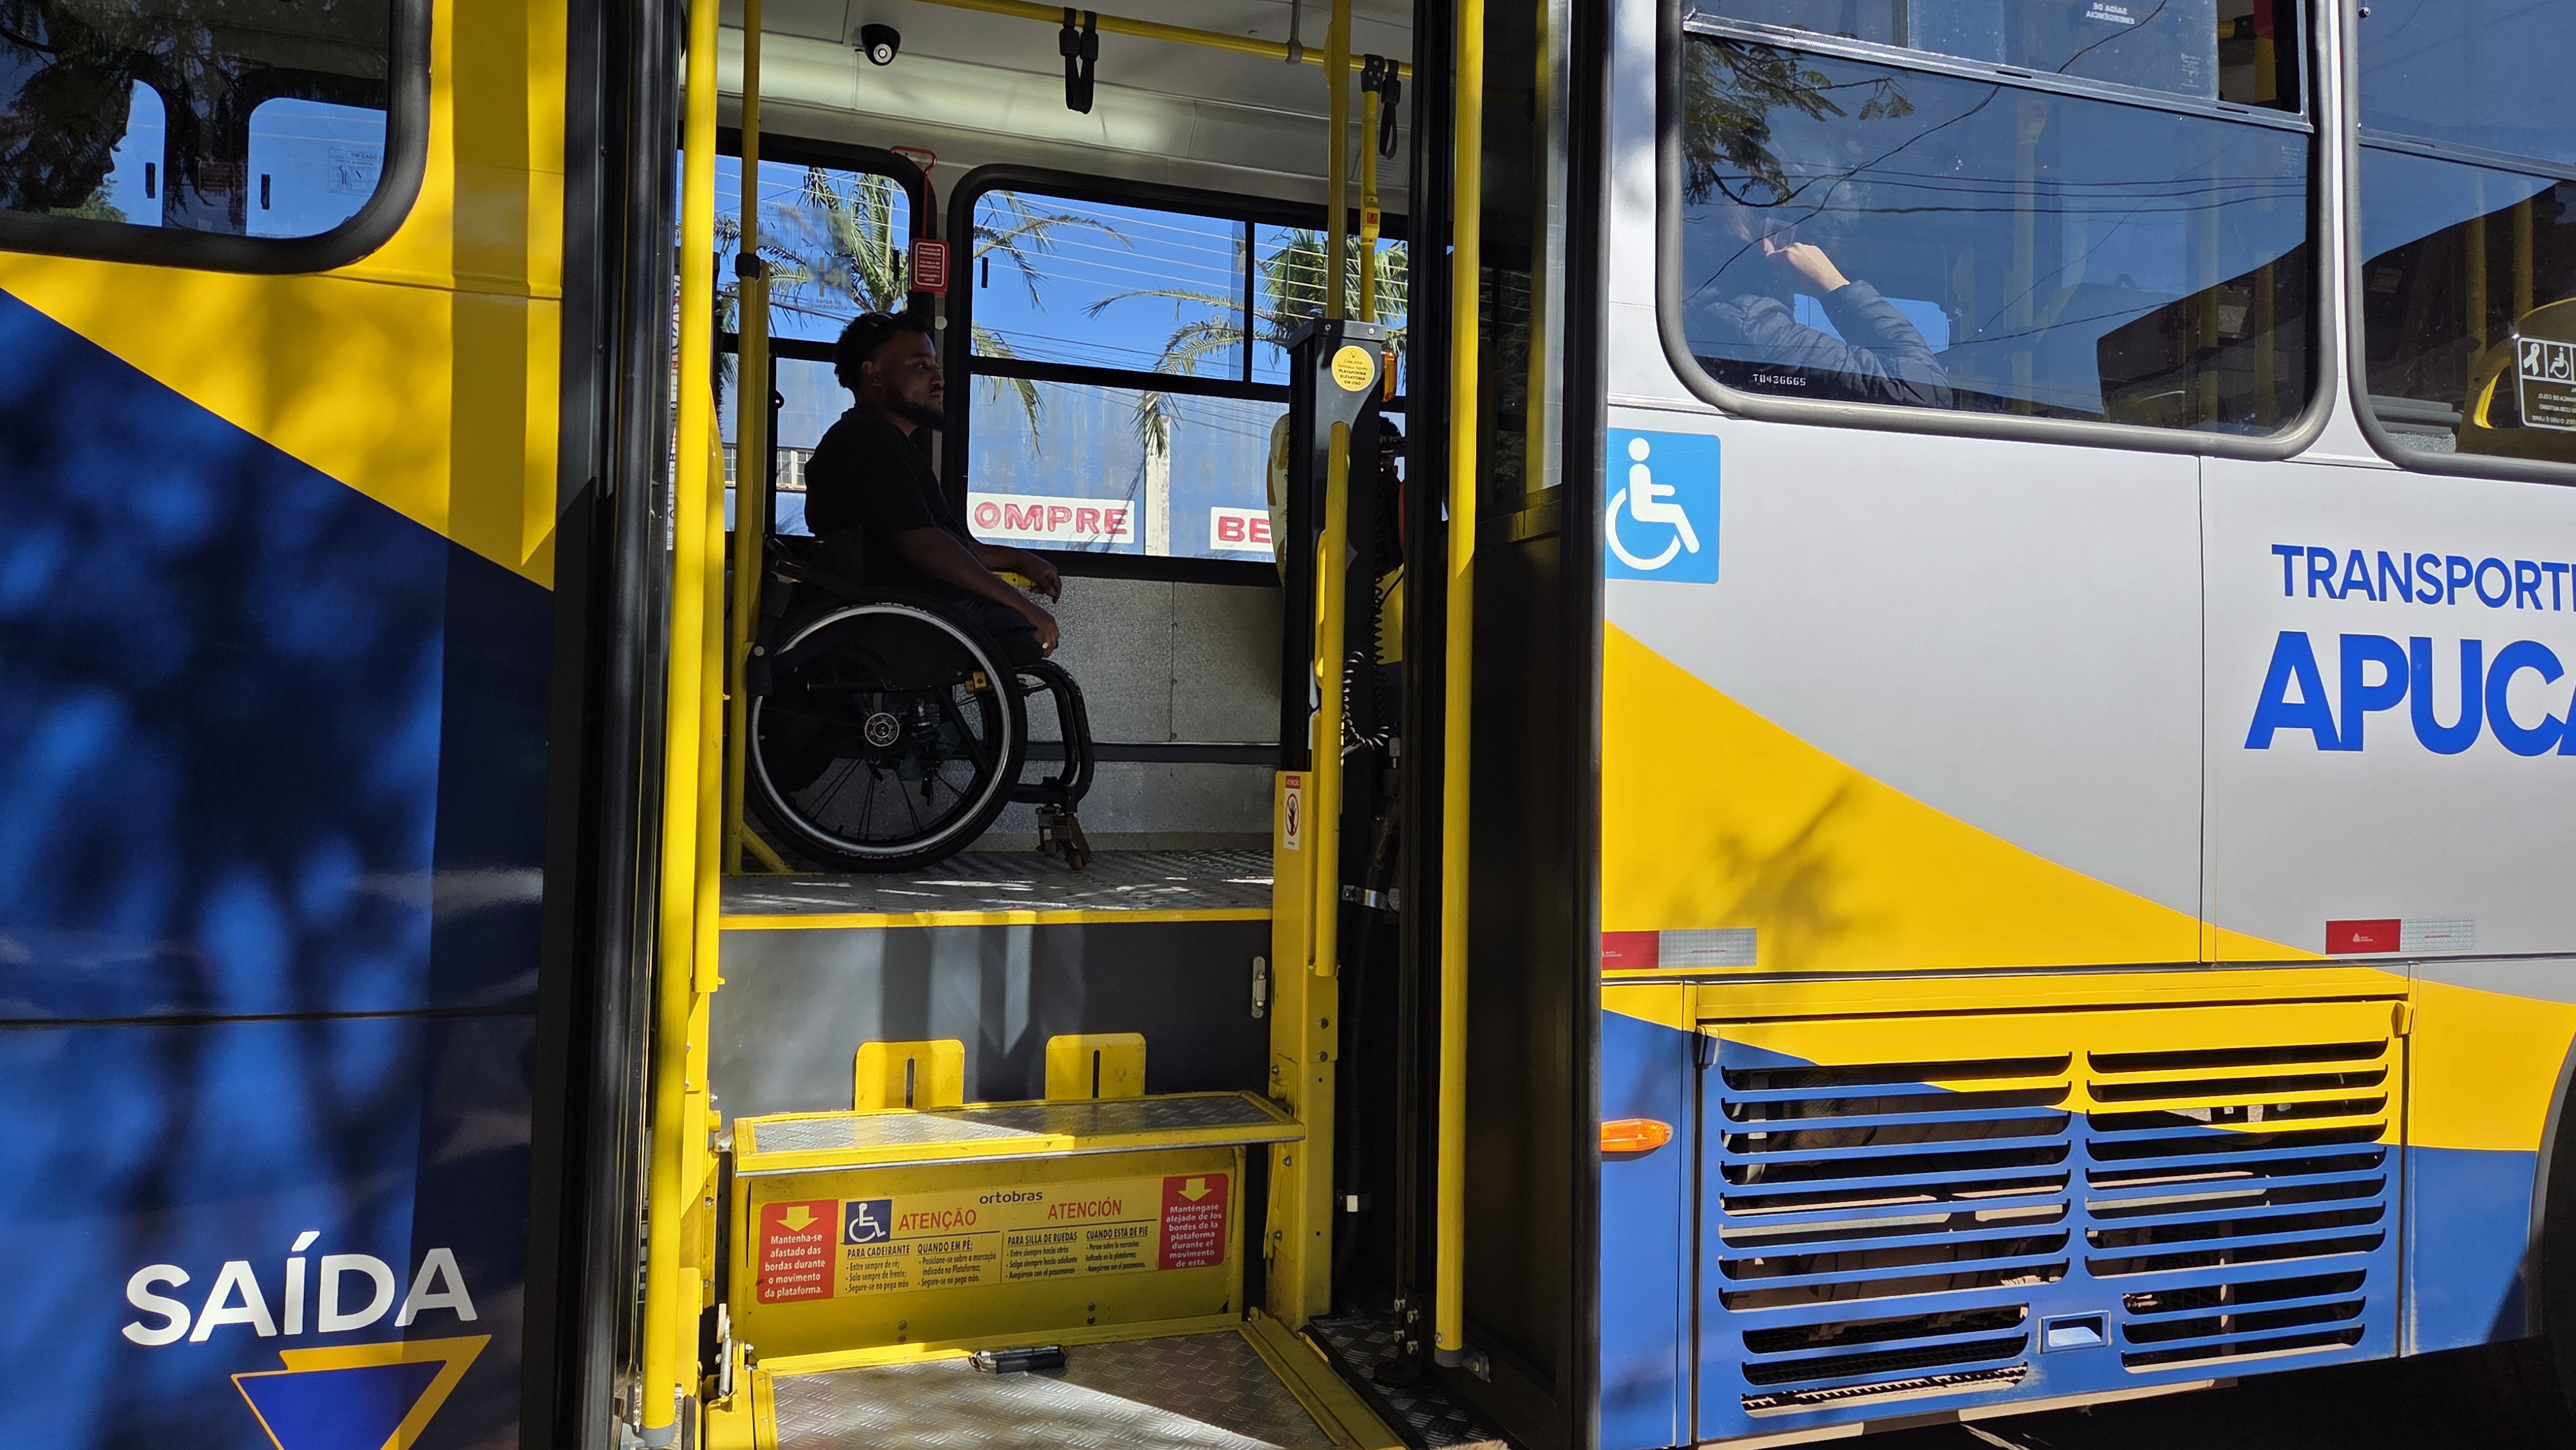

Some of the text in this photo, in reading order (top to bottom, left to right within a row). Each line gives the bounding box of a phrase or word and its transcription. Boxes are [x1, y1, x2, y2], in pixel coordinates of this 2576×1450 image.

[2271, 544, 2576, 612] TRANSPORT
[979, 1191, 1043, 1205] ortobras
[1047, 1196, 1122, 1220] ATENCIÓN
[1170, 1205, 1219, 1213] Manténgase
[898, 1207, 976, 1231] ATENÇÃO
[1166, 1214, 1196, 1223] alejado
[1009, 1231, 1077, 1245] PARA SILLA DE RUEDAS
[1086, 1226, 1148, 1239] CUANDO ESTA DE PIE
[1171, 1232, 1215, 1242] plataforma
[771, 1234, 822, 1245] Mantenha-se
[918, 1237, 972, 1254] QUANDO EM PÉ:
[770, 1245, 821, 1257] afastado das
[848, 1245, 909, 1258] PARA CADEIRANTE
[1024, 1248, 1042, 1257] siempre
[922, 1256, 952, 1265] Posicione-se
[954, 1254, 967, 1263] sobre
[973, 1252, 996, 1262] marcação
[1024, 1259, 1043, 1268] siempre
[765, 1259, 826, 1271] bordas durante
[850, 1262, 864, 1271] Entre
[864, 1262, 884, 1271] sempre
[776, 1273, 820, 1284] movimento
[862, 1272, 881, 1282] sempre
[882, 1270, 889, 1279] de
[122, 1230, 477, 1346] SAÍDA
[849, 1283, 875, 1294] Segure-se
[884, 1282, 896, 1292] pega
[898, 1279, 909, 1288] mão
[921, 1277, 946, 1288] Segure-se
[765, 1286, 823, 1299] da plataforma.
